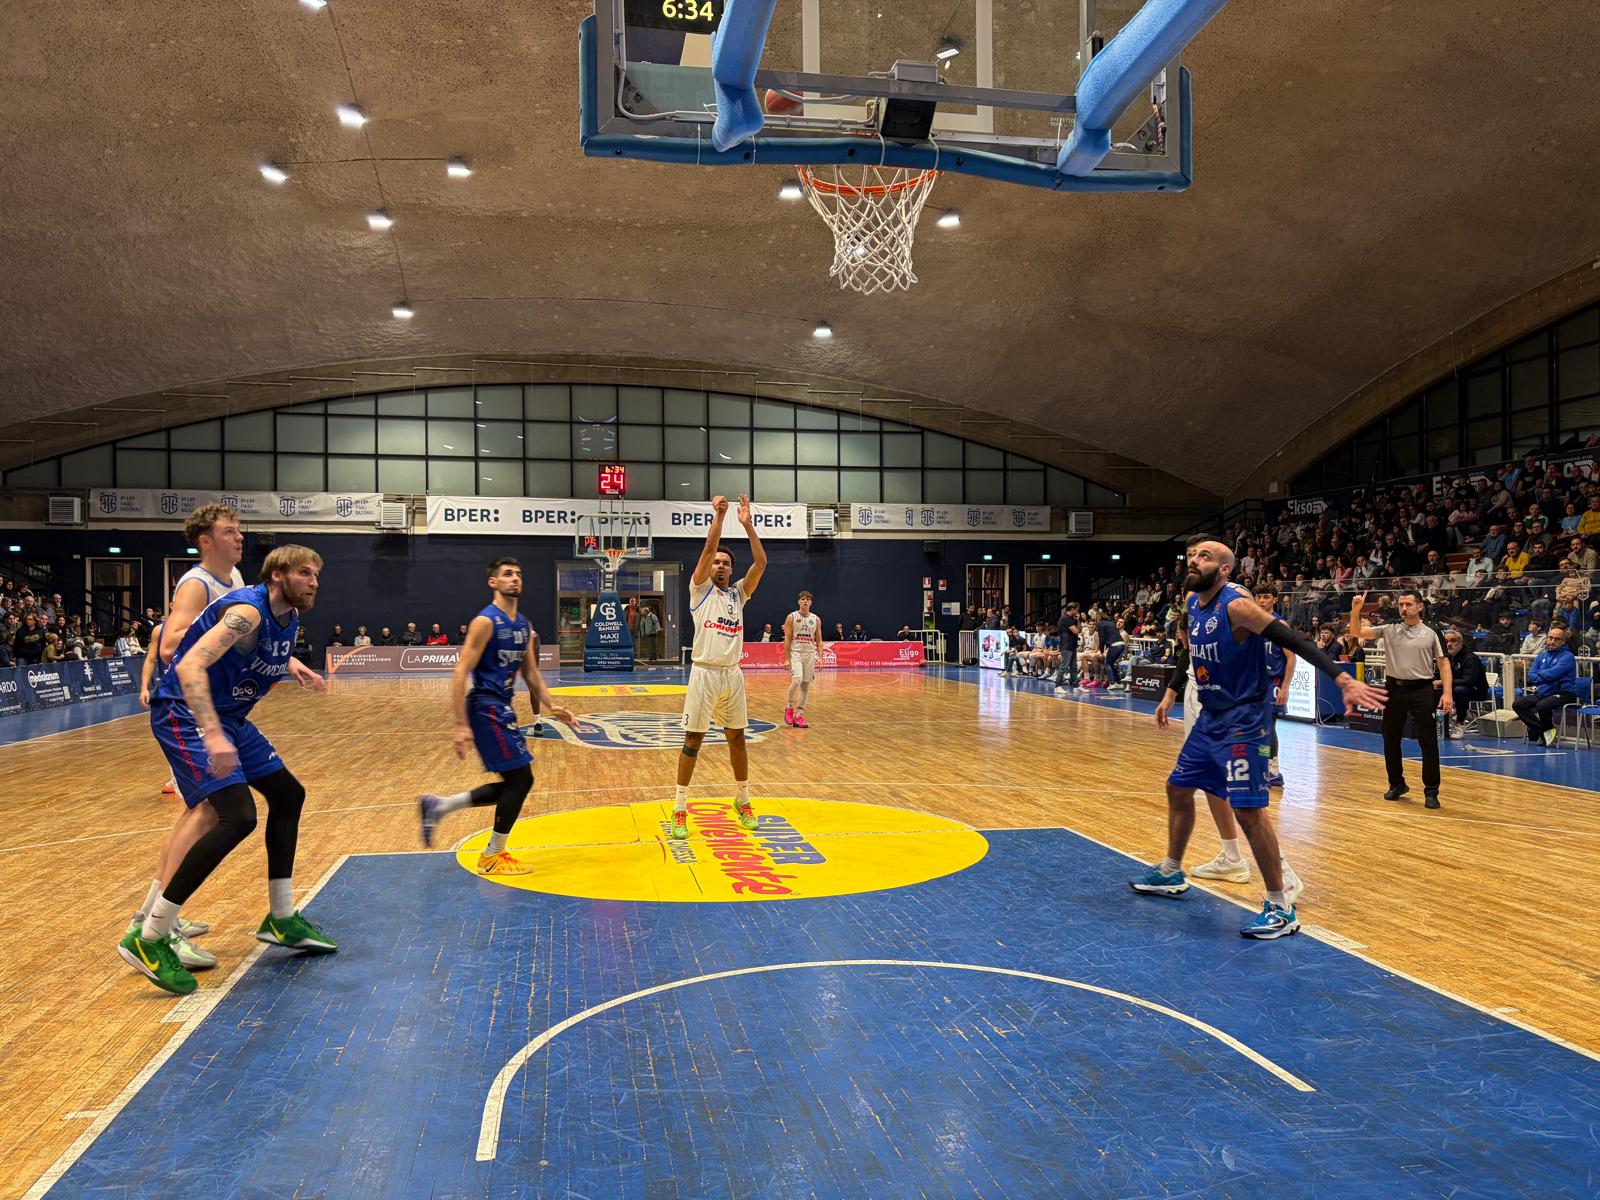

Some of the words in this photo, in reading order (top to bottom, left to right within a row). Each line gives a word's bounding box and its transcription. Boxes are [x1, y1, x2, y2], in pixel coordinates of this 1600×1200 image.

[662, 0, 714, 21] 6:34
[605, 466, 624, 474] 6:34
[600, 474, 624, 490] 24
[728, 604, 733, 614] 3
[272, 641, 291, 656] 13
[1136, 677, 1160, 688] C-HR
[1226, 758, 1250, 781] 12
[752, 815, 827, 864] SUPER
[686, 802, 798, 895] Conveniente
